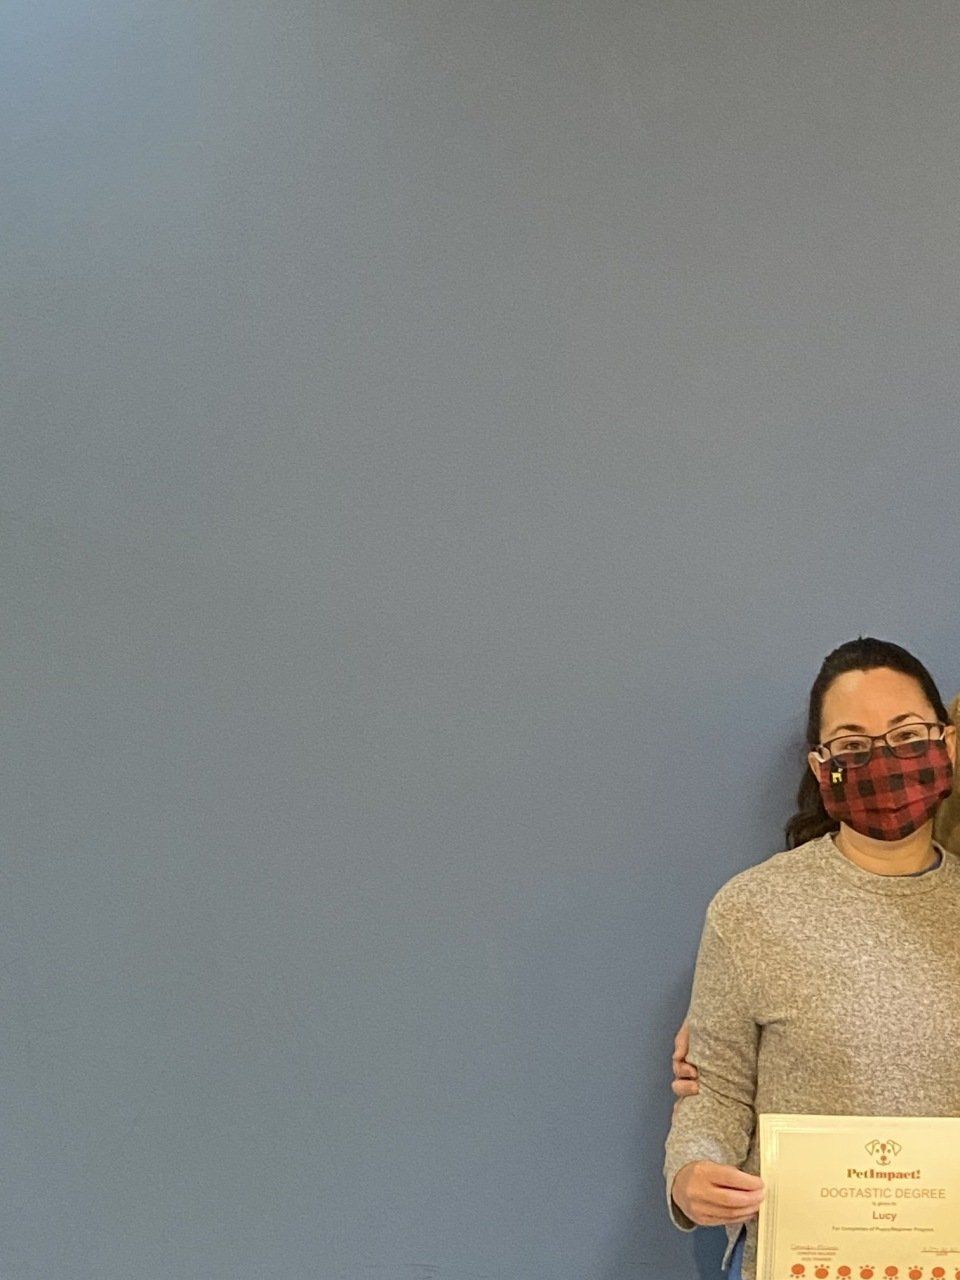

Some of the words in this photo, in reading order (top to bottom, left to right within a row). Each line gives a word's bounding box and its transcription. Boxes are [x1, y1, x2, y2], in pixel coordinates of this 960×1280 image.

[820, 1187, 892, 1198] DOGTASTIC
[895, 1188, 946, 1199] DEGREE
[872, 1210, 898, 1222] Lucy
